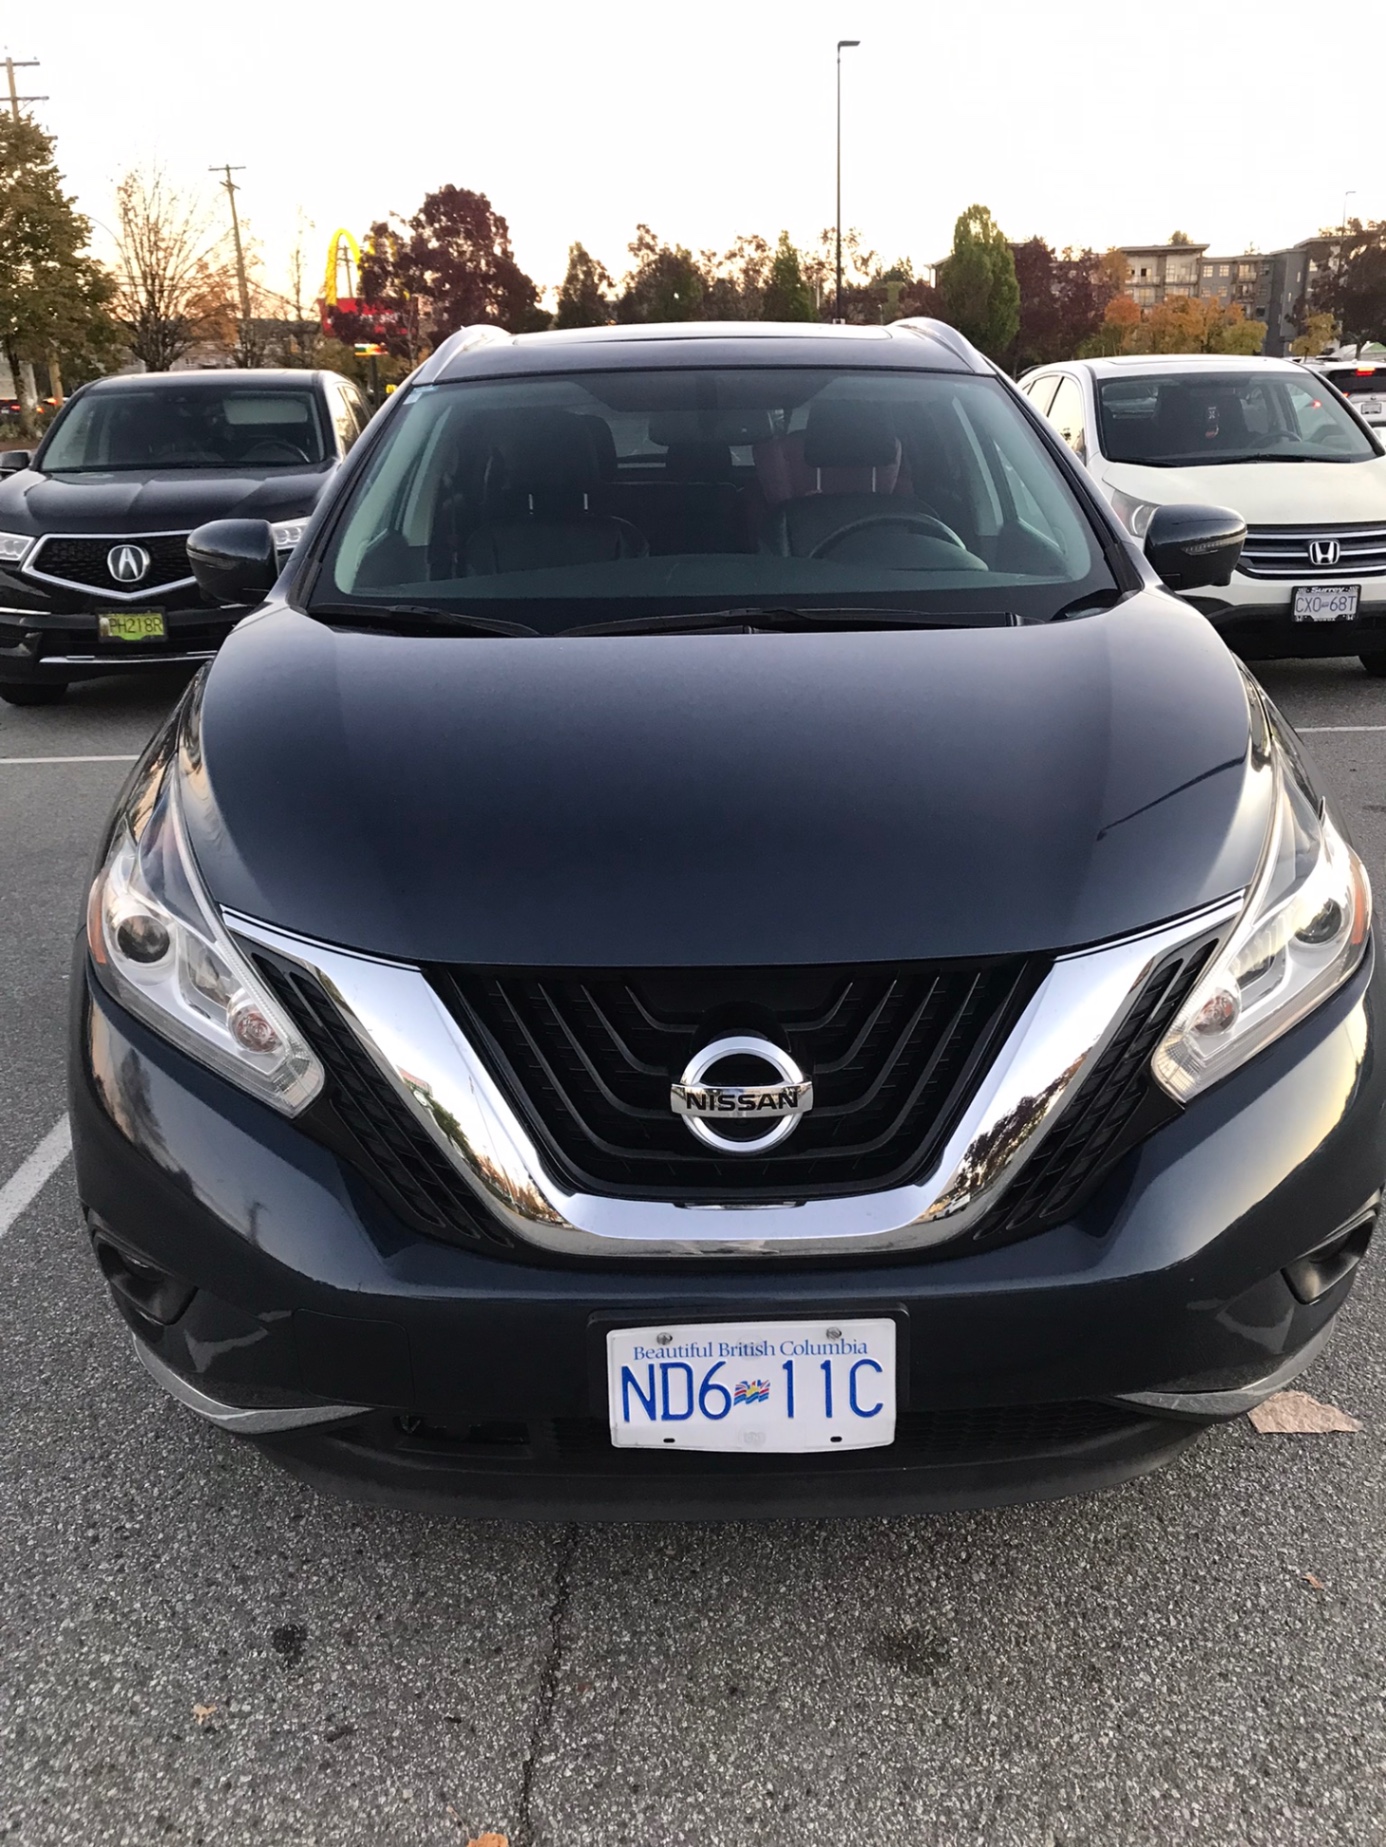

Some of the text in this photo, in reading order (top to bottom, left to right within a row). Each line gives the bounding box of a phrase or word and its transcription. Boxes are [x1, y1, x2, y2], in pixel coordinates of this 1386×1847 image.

[686, 1091, 799, 1112] NISSAN
[633, 1338, 868, 1361] Beautiful British Columbia
[621, 1358, 884, 1423] ND6 11C
